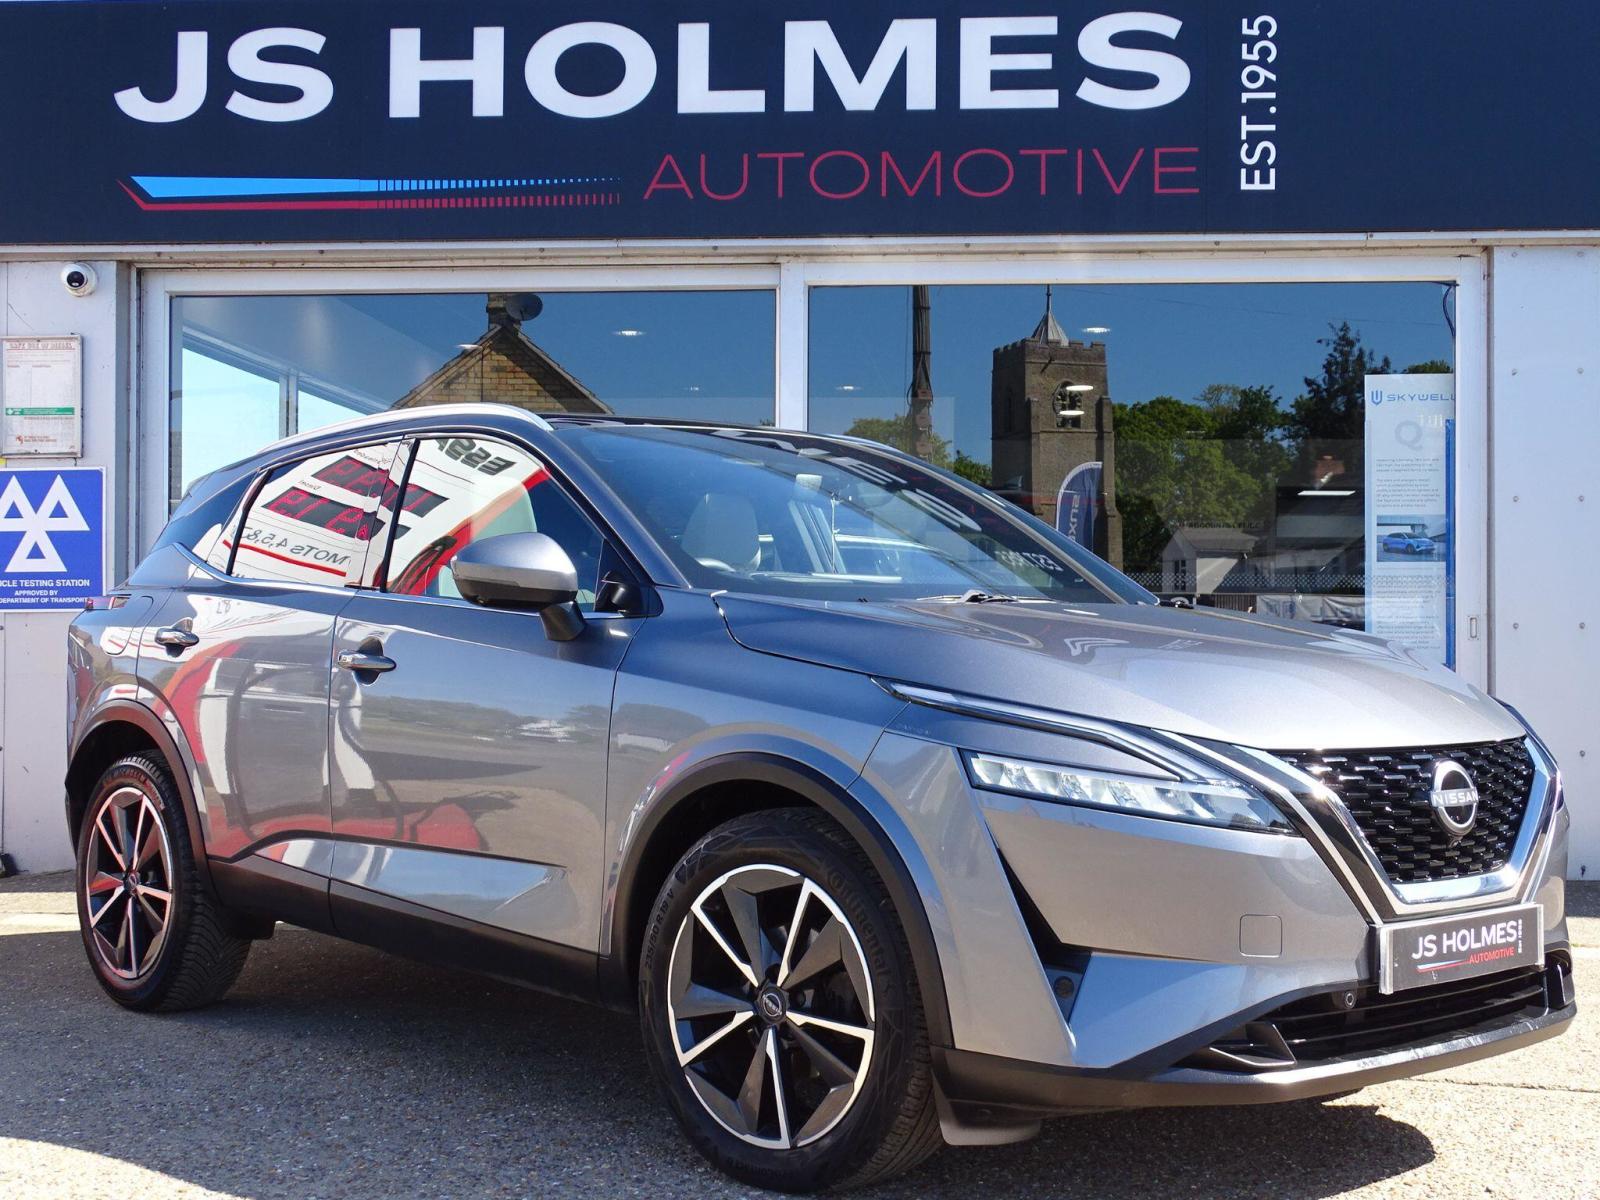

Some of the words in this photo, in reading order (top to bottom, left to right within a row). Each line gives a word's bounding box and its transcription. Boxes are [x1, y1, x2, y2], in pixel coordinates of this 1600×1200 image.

[113, 27, 334, 123] JS
[388, 12, 1192, 119] HOLMES
[1240, 14, 1278, 192] EST.1955
[643, 146, 1200, 200] AUTOMOTIVE
[19, 579, 54, 587] TESTING
[55, 579, 90, 587] STATION
[1431, 790, 1479, 807] NISSAN
[1411, 934, 1438, 960] JS
[1442, 920, 1518, 954] HOLMES
[1469, 946, 1515, 964] AUTOMOTIVE
